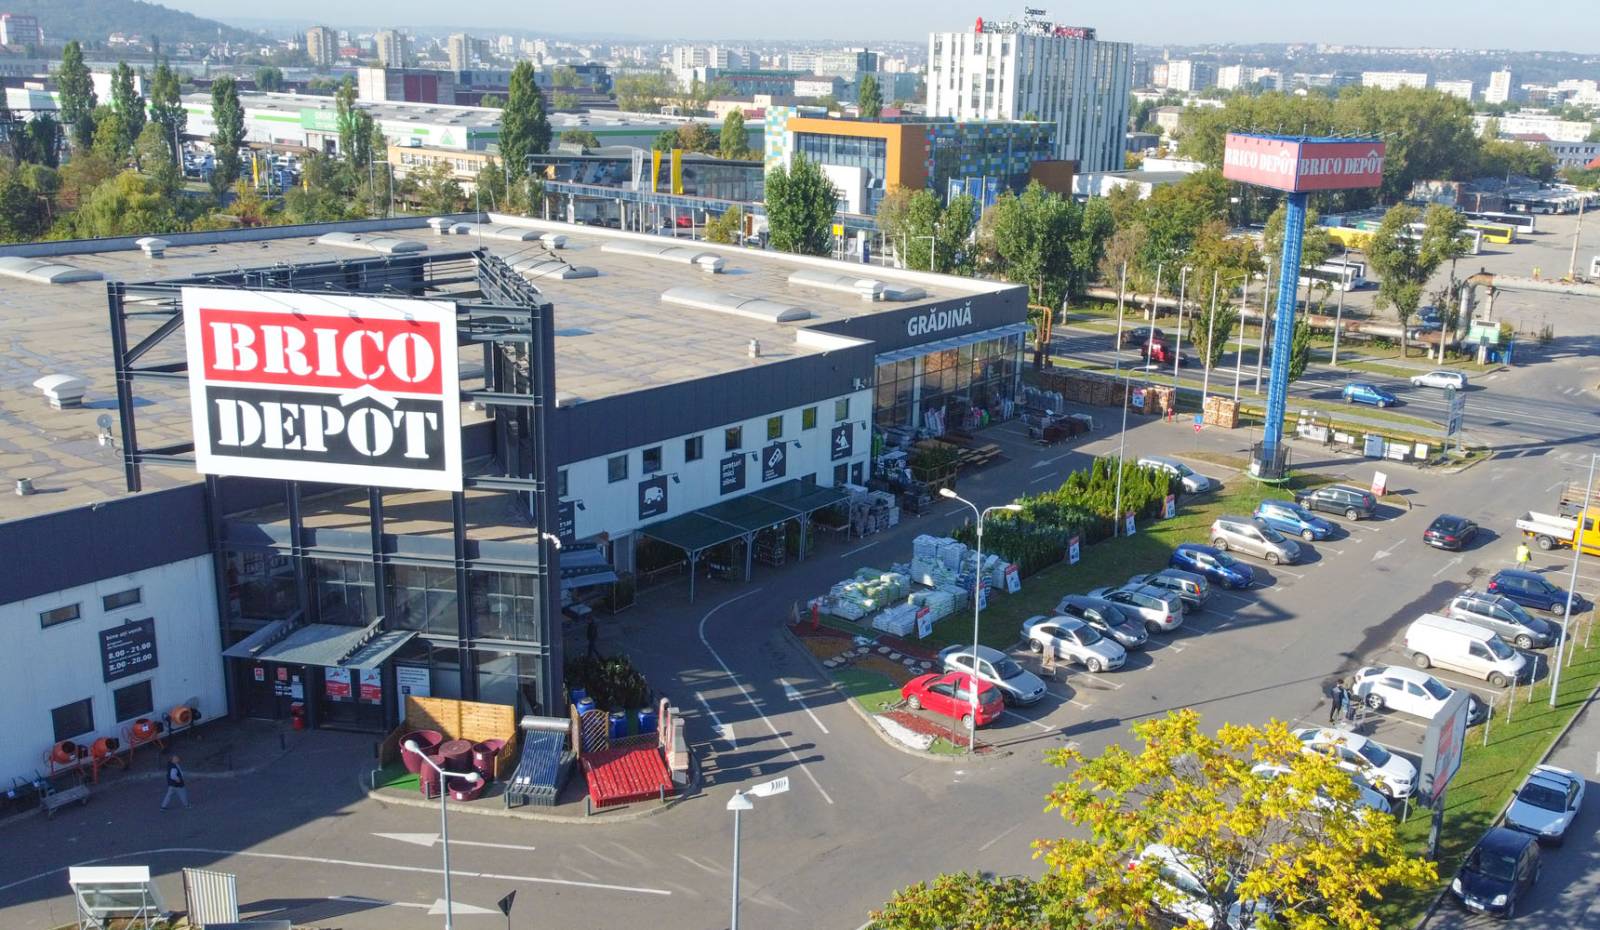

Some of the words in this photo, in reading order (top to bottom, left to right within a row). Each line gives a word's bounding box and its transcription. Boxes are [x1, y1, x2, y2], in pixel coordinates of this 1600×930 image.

[1225, 147, 1258, 170] BRICO
[1258, 149, 1298, 176] DEPÔT
[1300, 157, 1342, 176] BRICO
[1344, 150, 1385, 174] DEPÔT
[907, 300, 972, 337] GRĂDINĂ
[208, 321, 435, 383] BRICO
[214, 384, 438, 460] DEPÔT
